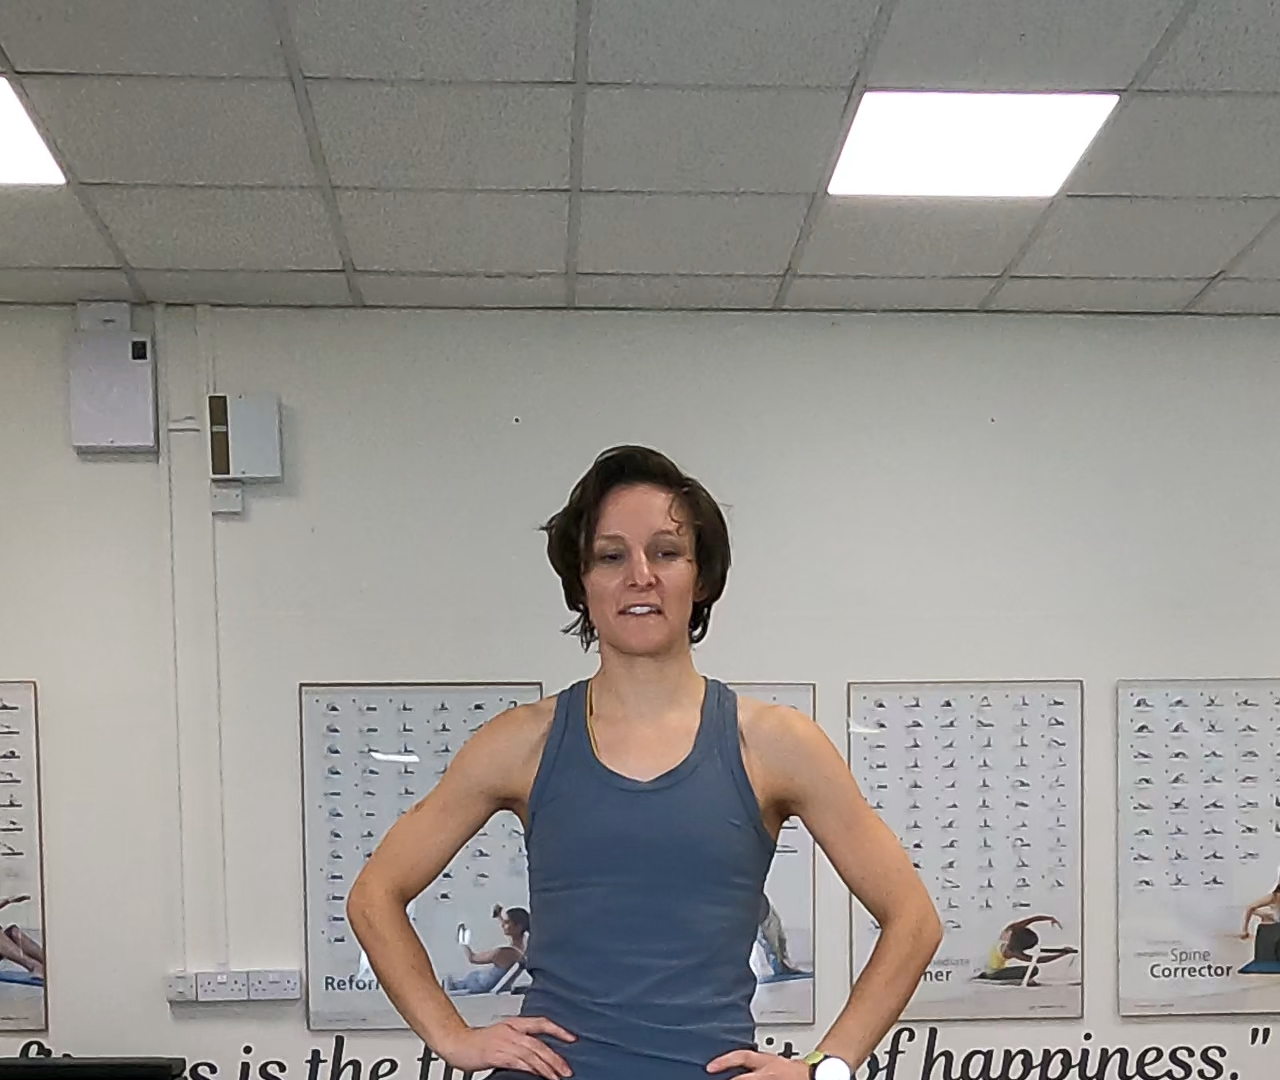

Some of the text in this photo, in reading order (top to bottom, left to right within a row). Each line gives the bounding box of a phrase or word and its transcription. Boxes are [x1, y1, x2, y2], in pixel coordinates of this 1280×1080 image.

[1171, 948, 1211, 962] Spine
[1150, 964, 1233, 978] Corrector
[324, 974, 380, 991] Refor
